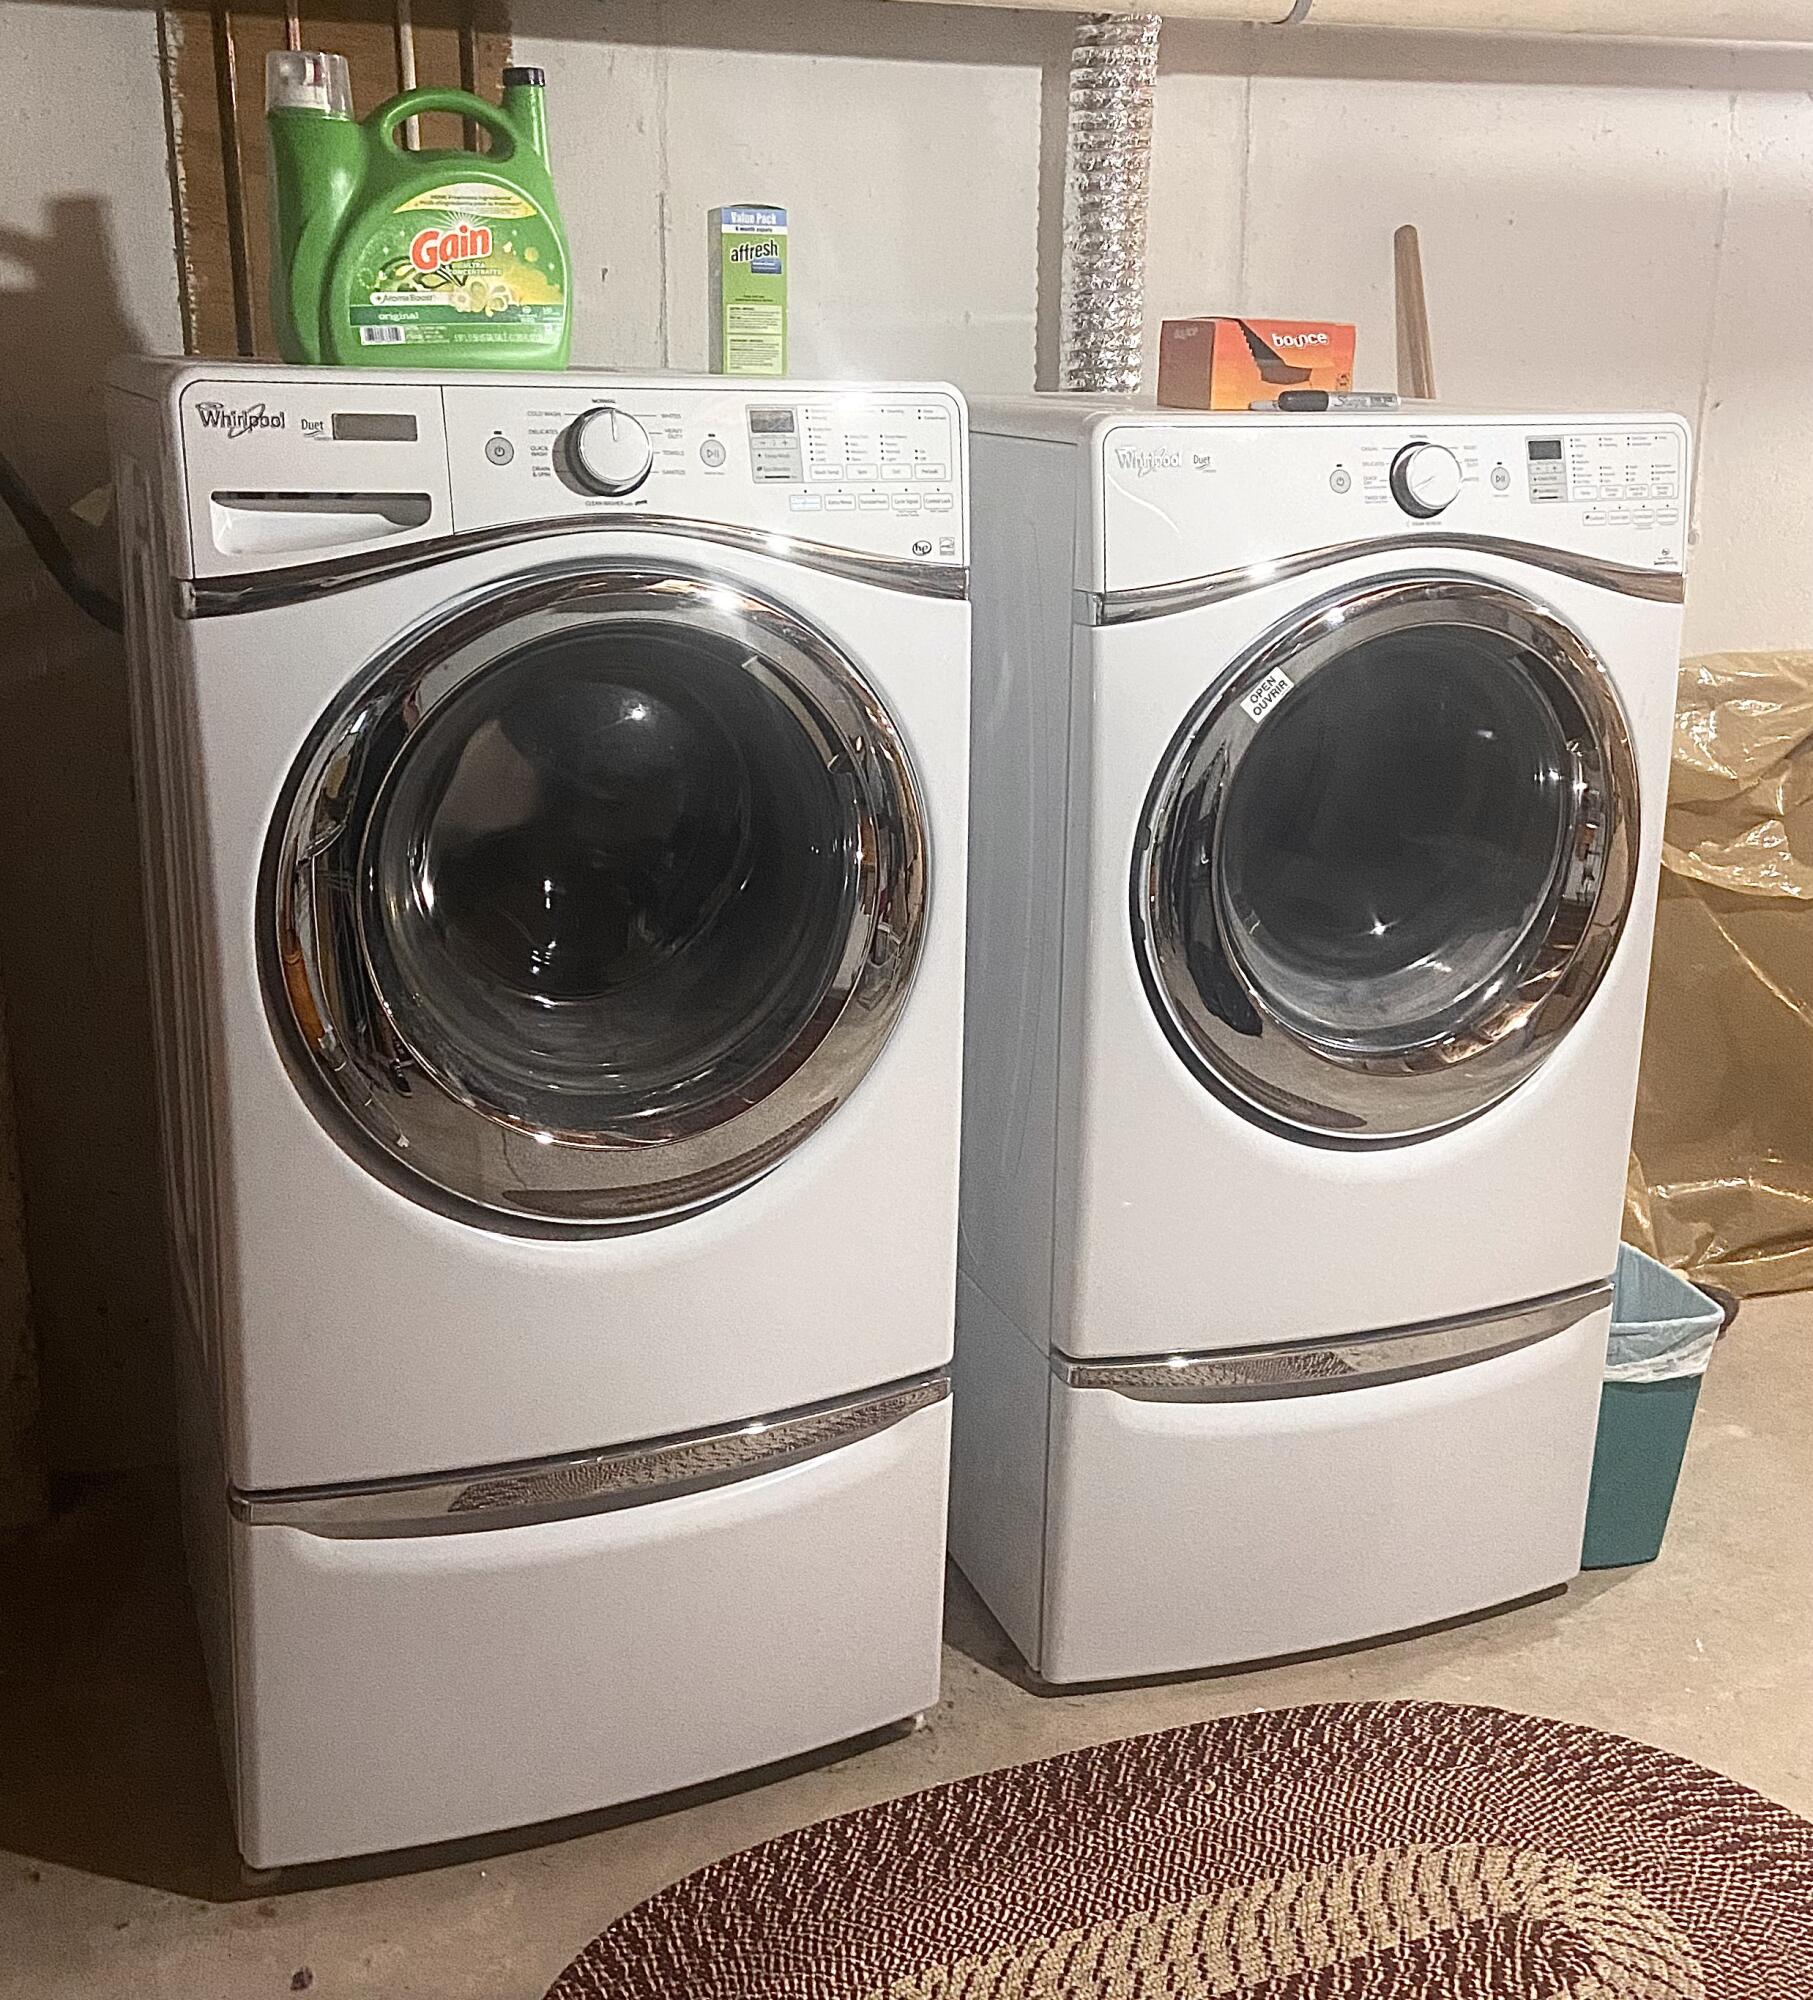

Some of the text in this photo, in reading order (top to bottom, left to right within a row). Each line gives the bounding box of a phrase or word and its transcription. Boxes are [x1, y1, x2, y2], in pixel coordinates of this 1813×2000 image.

[730, 211, 777, 224] Value Pack
[411, 224, 491, 270] Gain
[731, 239, 778, 262] affresh
[378, 311, 419, 321] original
[1271, 333, 1328, 348] bounce
[196, 402, 324, 436] Whirlpool Duet
[1115, 448, 1210, 475] Whirlpool Duet
[1250, 675, 1277, 703] OPEN
[1253, 680, 1288, 716] OUVRIR
